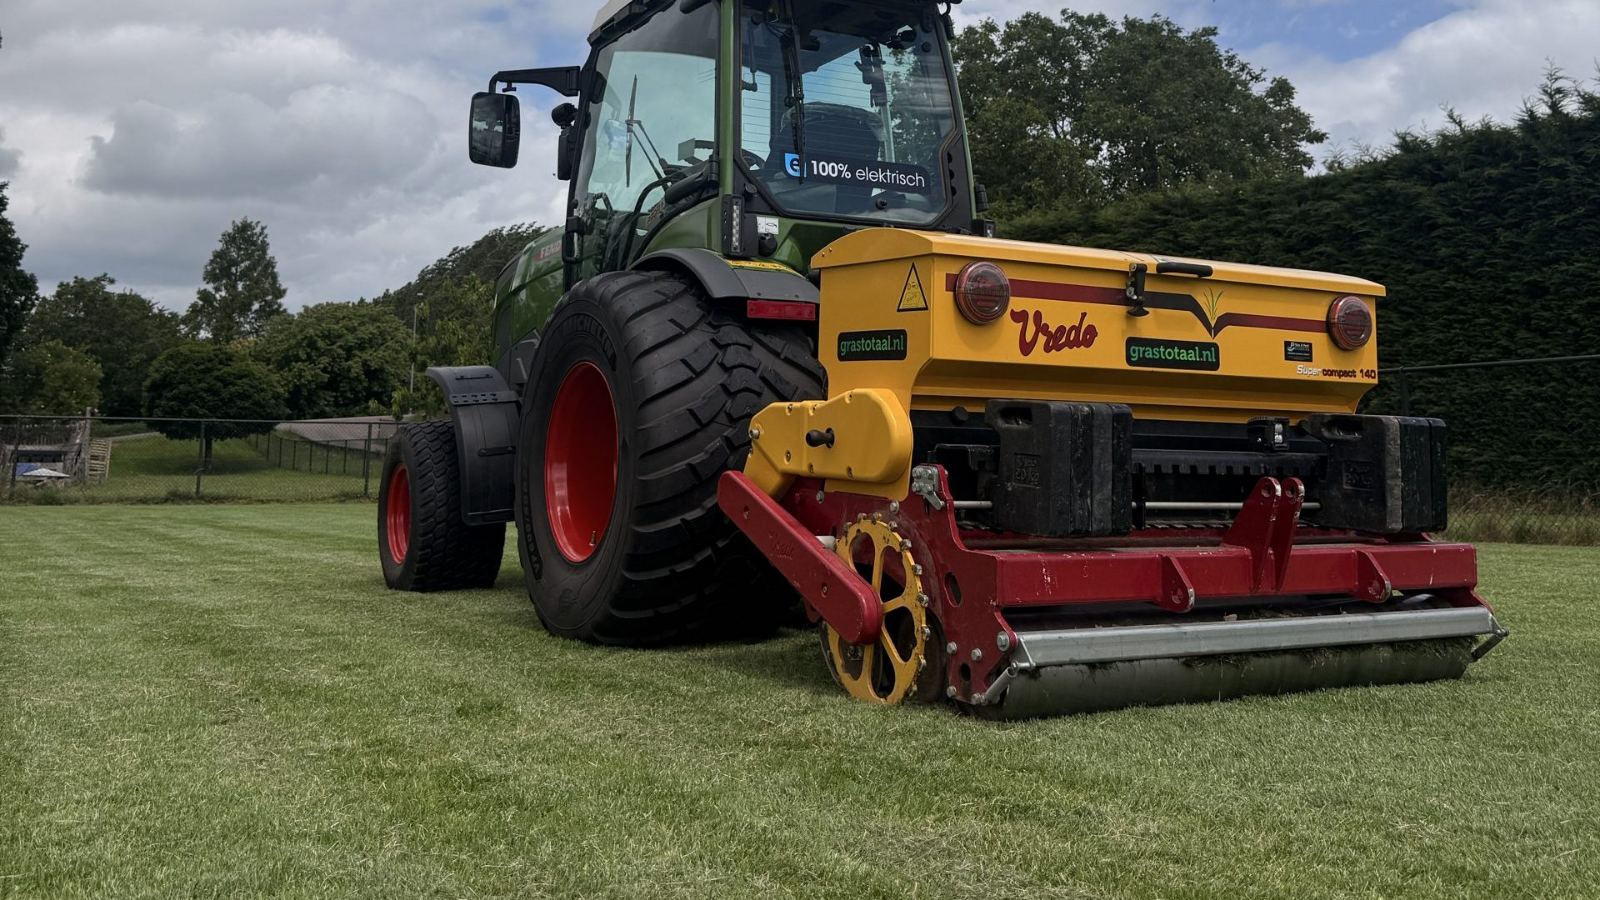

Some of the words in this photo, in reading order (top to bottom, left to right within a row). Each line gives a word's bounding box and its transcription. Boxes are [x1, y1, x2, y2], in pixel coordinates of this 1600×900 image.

[811, 160, 852, 179] 100%
[855, 166, 925, 187] elektrisch
[1010, 308, 1098, 357] Vredo
[840, 335, 904, 357] grastotaal.nl
[1129, 345, 1216, 362] grastotaal.nl
[1359, 368, 1377, 379] 140
